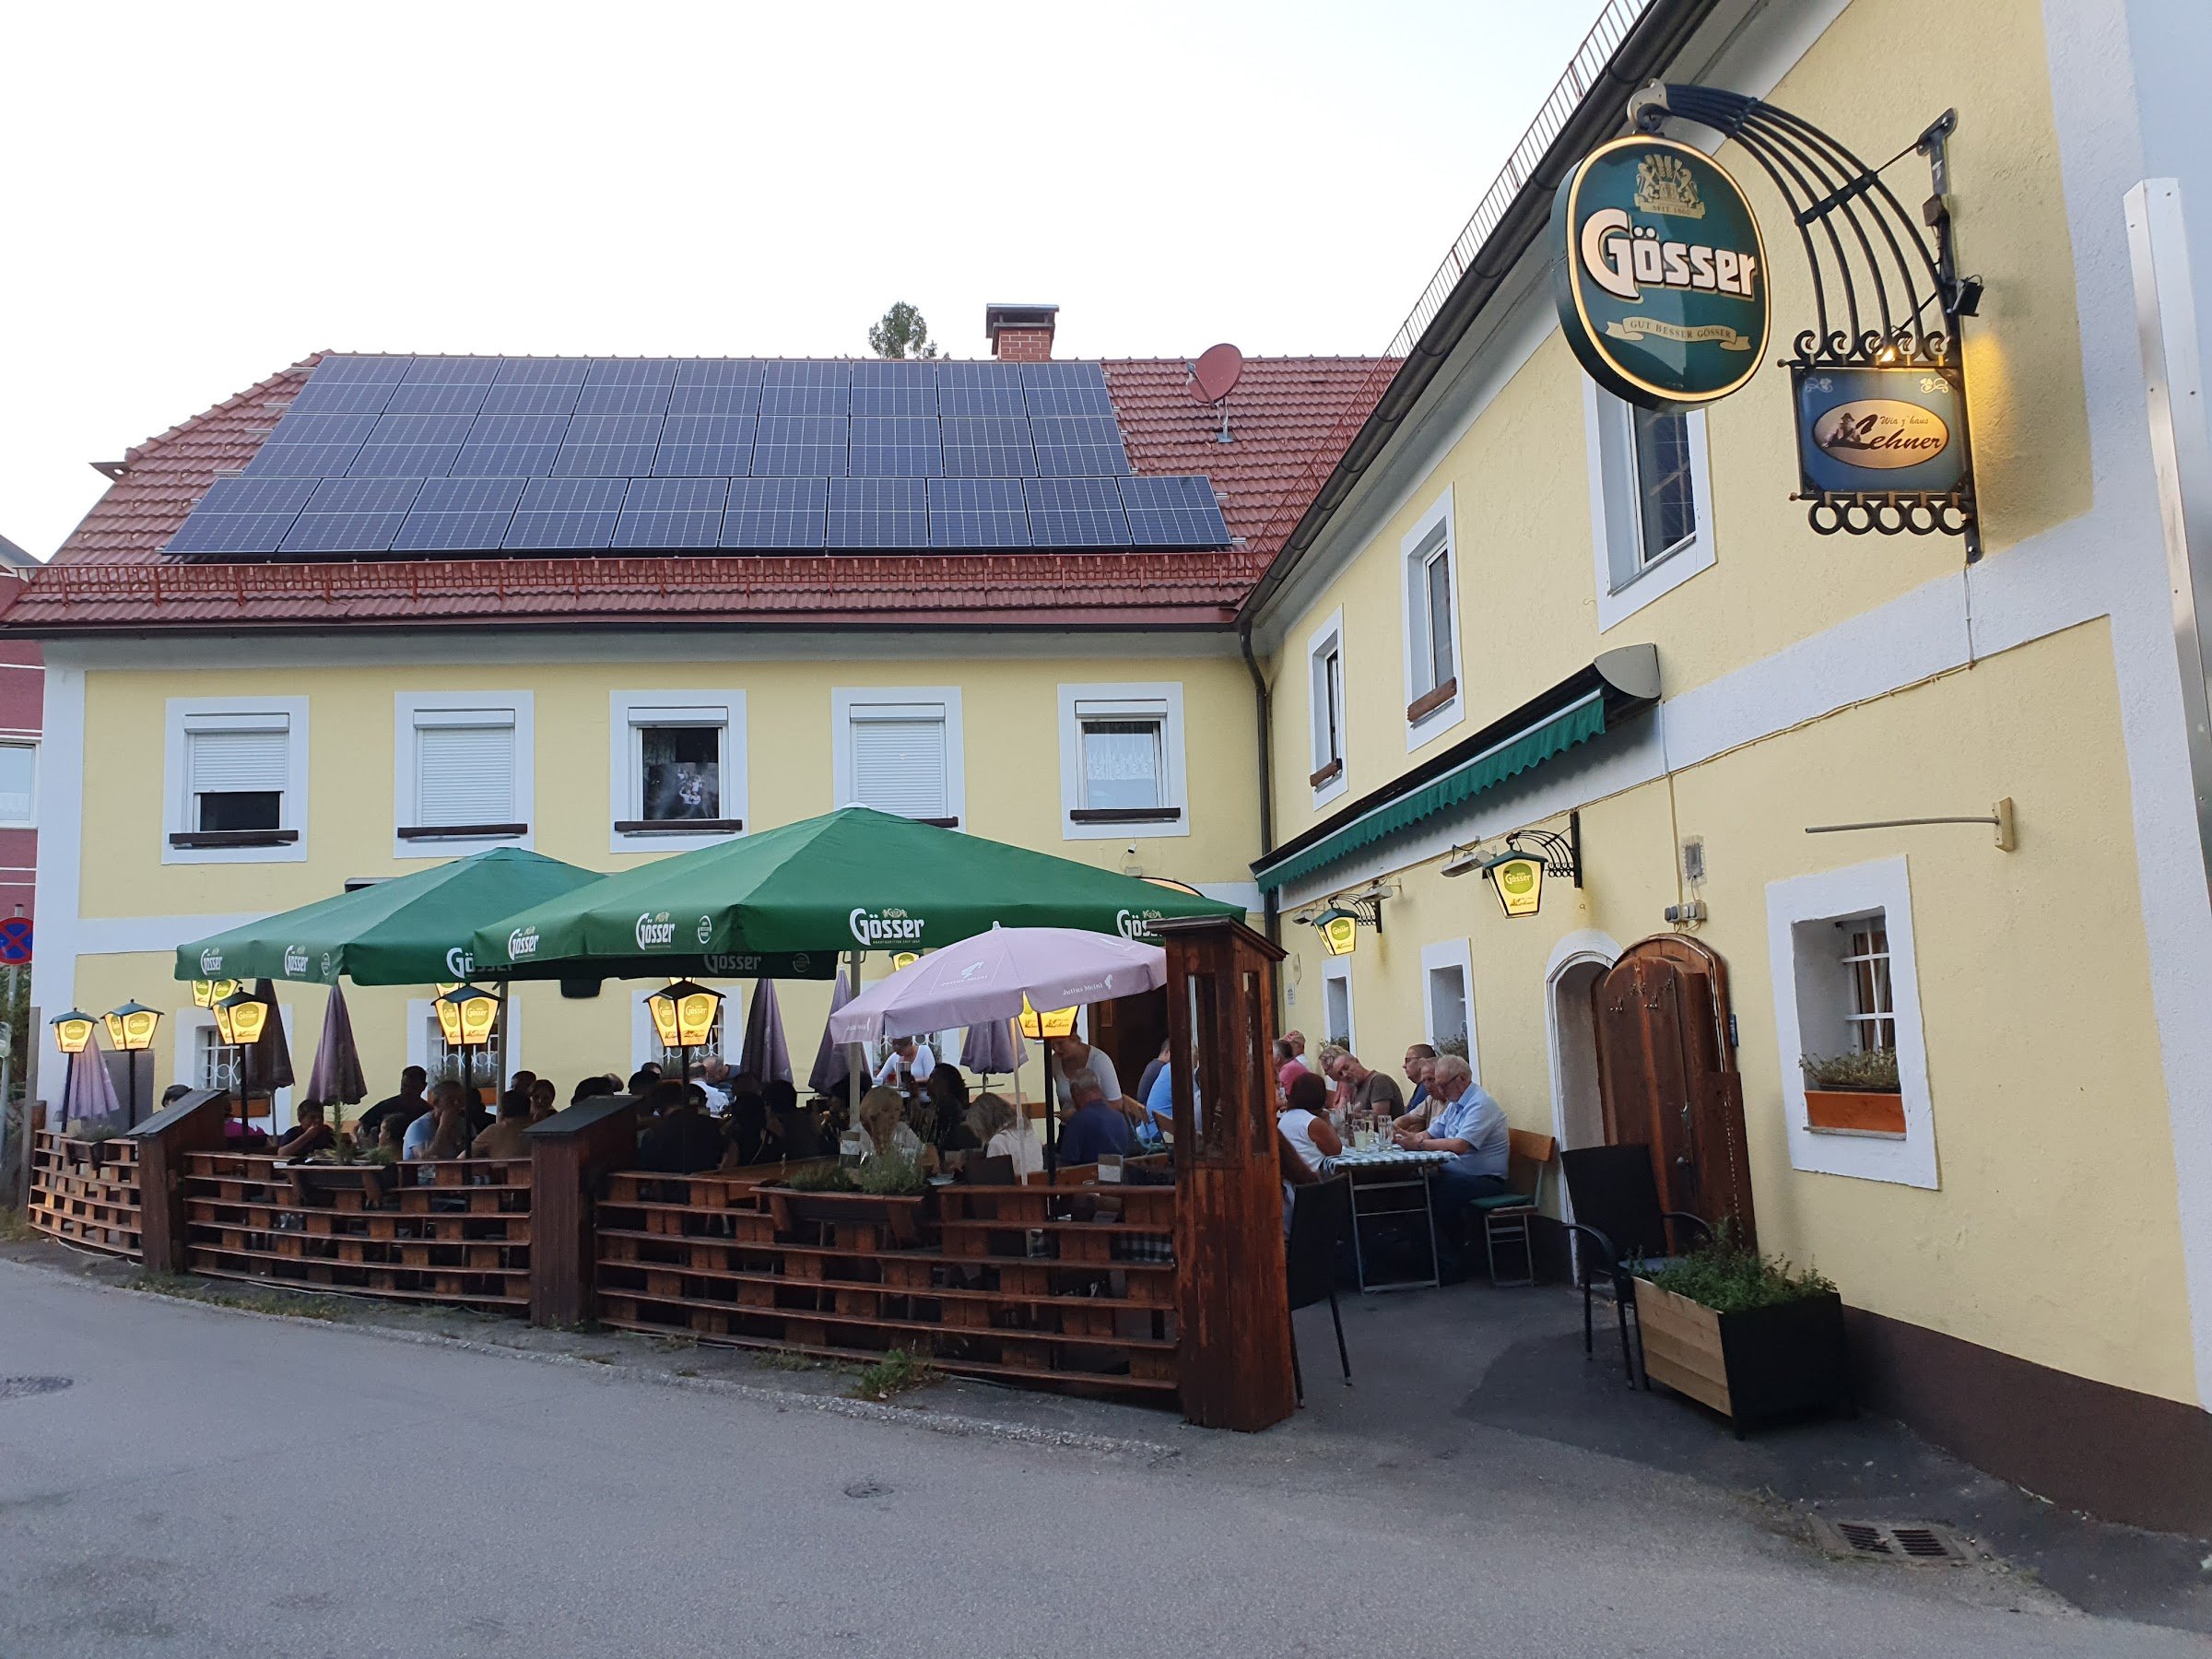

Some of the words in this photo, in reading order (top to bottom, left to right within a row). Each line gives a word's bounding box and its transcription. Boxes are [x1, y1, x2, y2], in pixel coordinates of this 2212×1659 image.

[1582, 208, 1755, 299] Gösser
[1630, 321, 1651, 329] GUT
[1656, 324, 1693, 338] BESSER
[1829, 414, 1942, 450] Lehner
[1880, 416, 1898, 425] Wia
[1505, 873, 1531, 885] Gösser
[635, 912, 676, 950] Gösser
[849, 908, 924, 946] Gösser
[508, 928, 539, 960] Gösser
[200, 947, 223, 976] Gösser
[285, 945, 308, 976] Gösser
[1063, 986, 1084, 995] Julius
[1084, 982, 1104, 991] Meinl
